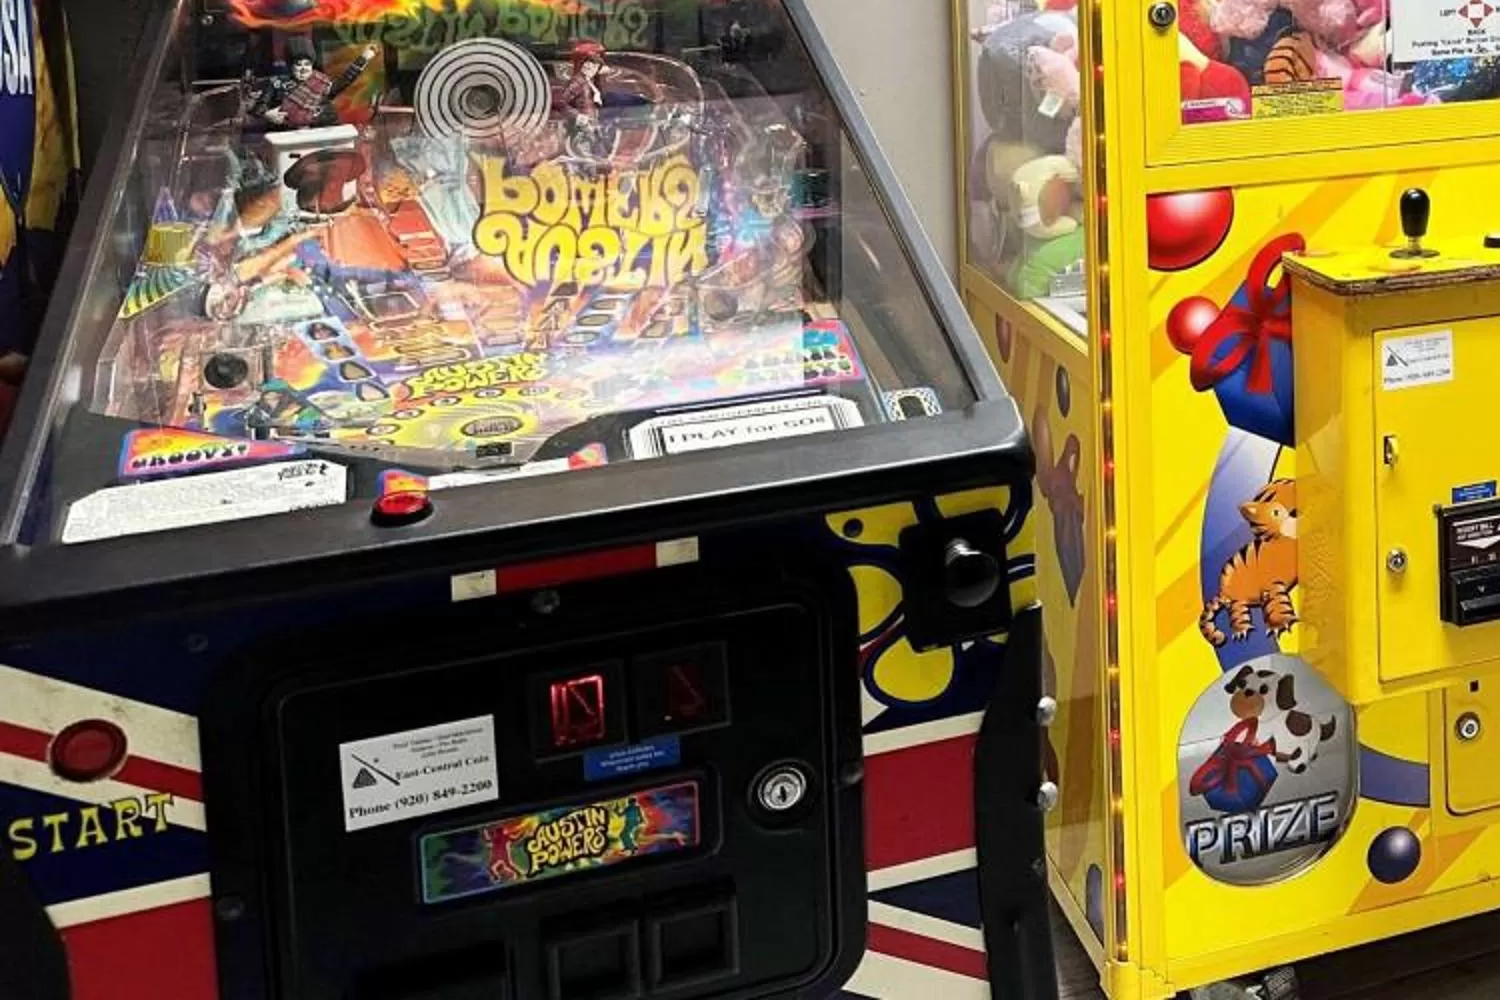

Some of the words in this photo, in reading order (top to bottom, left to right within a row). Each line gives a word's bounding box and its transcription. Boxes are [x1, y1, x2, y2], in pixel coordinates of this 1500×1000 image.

[682, 426, 739, 443] PLAY
[349, 801, 392, 820] Phone
[395, 791, 430, 810] (920)
[432, 779, 494, 802] 849-2200
[7, 792, 174, 861] START
[527, 807, 606, 853] AUSTIN
[530, 825, 607, 873] POWERS
[1185, 790, 1342, 870] PRIZE
